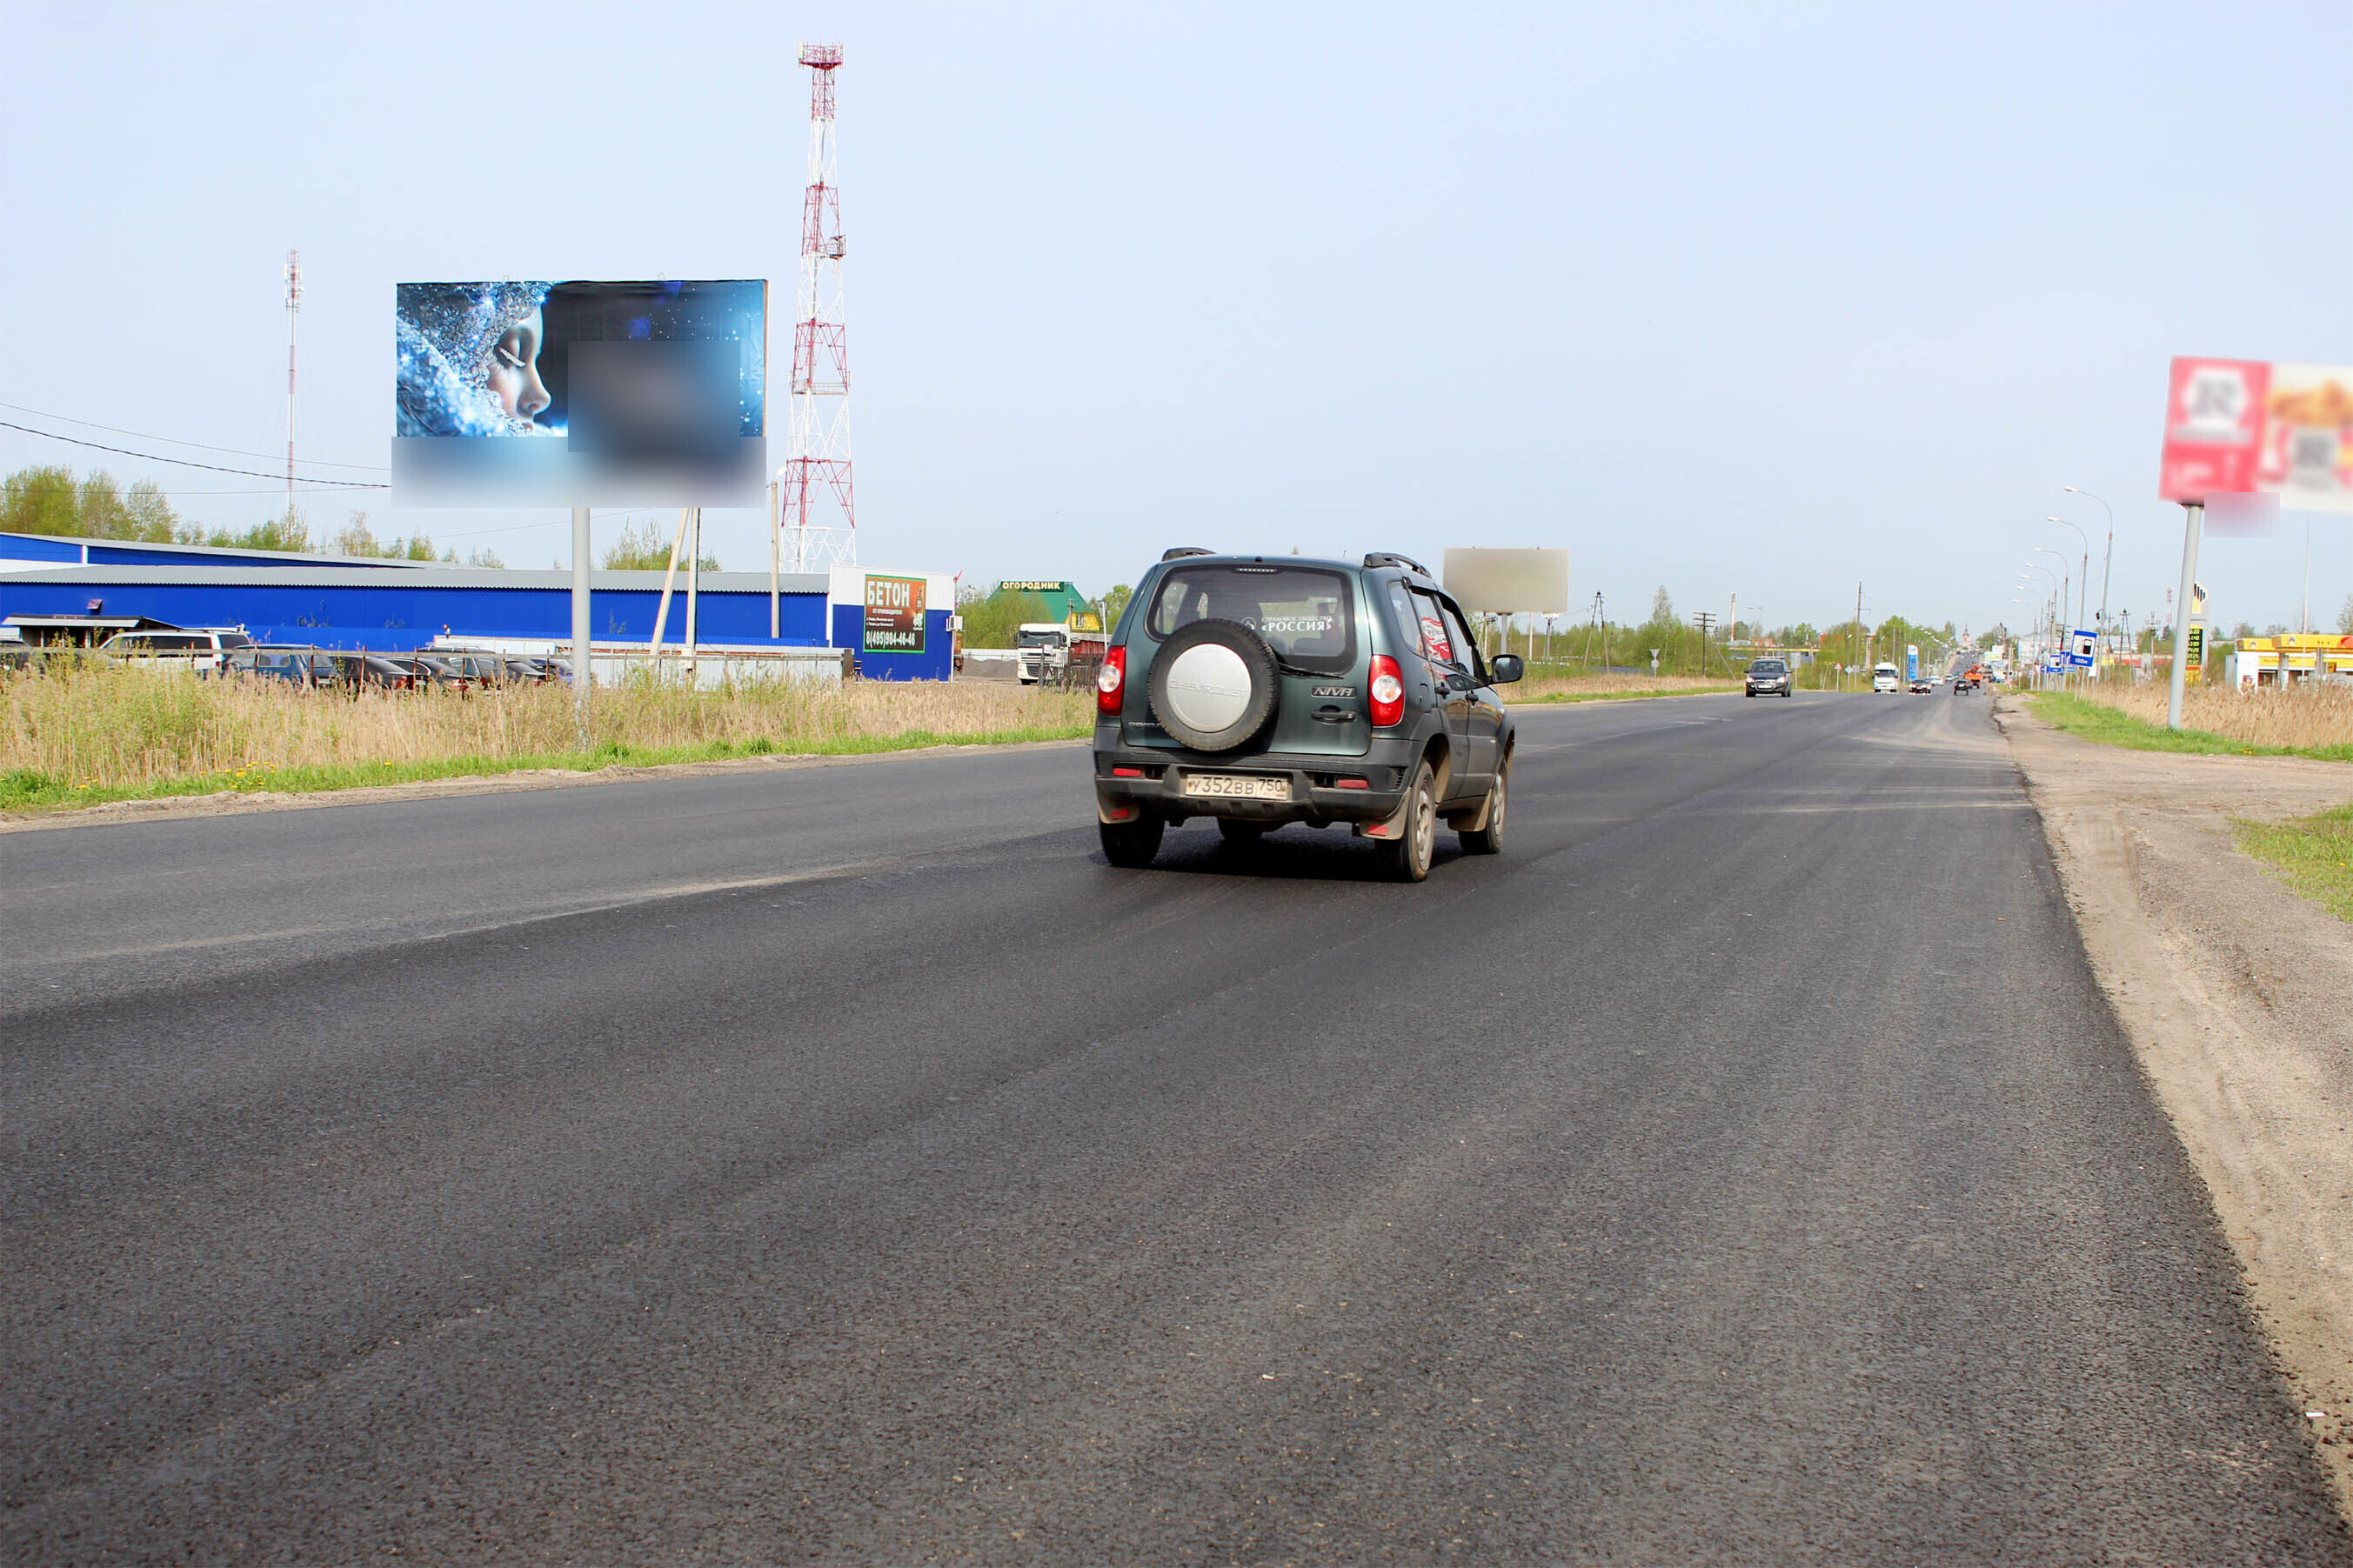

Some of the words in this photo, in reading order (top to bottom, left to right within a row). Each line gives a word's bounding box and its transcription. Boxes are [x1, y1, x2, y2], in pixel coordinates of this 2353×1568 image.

[866, 580, 910, 608] БЕТОН
[1313, 686, 1354, 697] NIVA
[1258, 778, 1283, 792] 750
